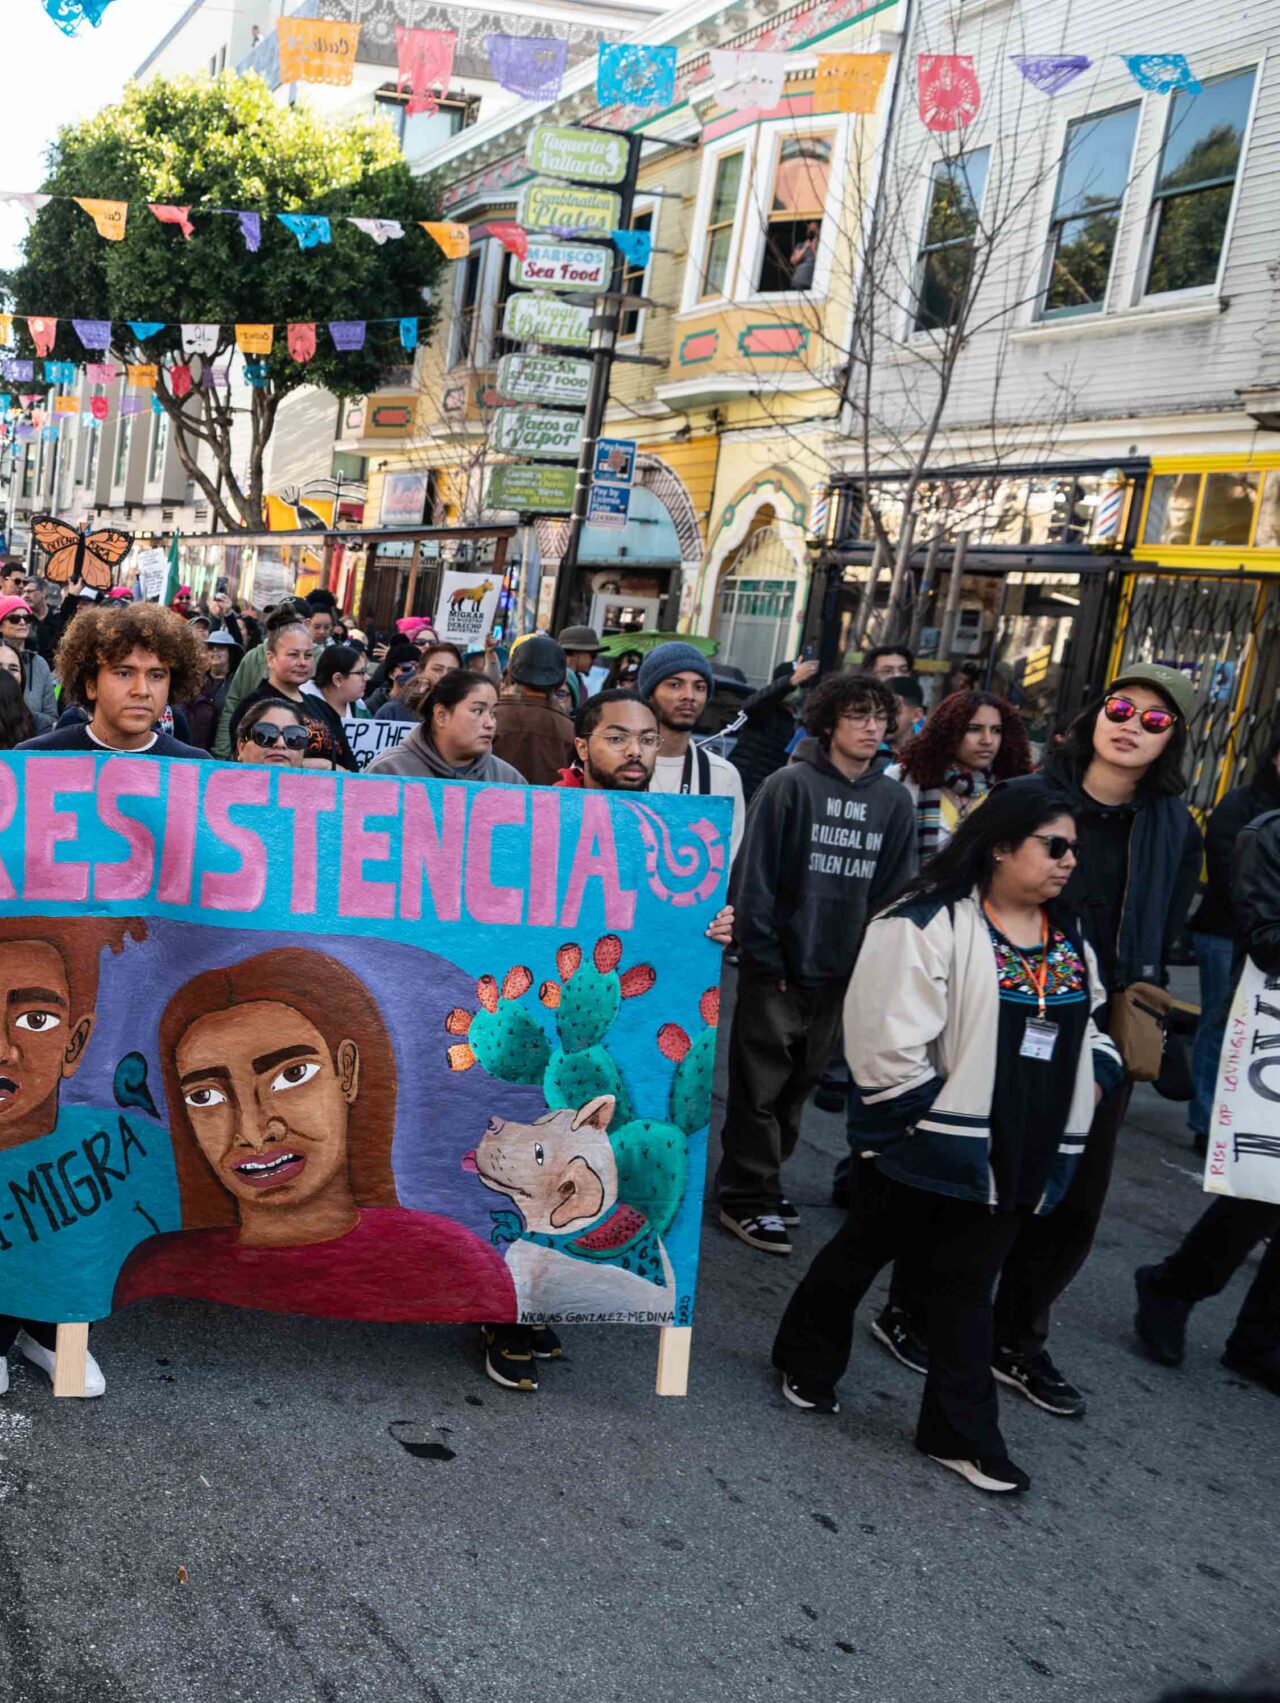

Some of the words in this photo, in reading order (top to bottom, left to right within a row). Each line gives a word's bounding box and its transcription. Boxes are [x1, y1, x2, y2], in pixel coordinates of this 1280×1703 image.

[541, 132, 606, 155] Taqueria
[540, 150, 606, 175] Vallarta
[533, 190, 610, 210] Combination
[532, 203, 607, 229] Plates
[526, 247, 604, 264] MARISCOS
[524, 260, 556, 279] Sea
[560, 264, 601, 282] Food
[556, 375, 589, 388] FOOD
[515, 415, 560, 432] Tacos
[563, 420, 580, 432] al
[506, 427, 577, 448] Vapor
[447, 621, 482, 629] DERECHO
[448, 610, 485, 619] MIGRAR
[375, 722, 412, 750] THE
[827, 797, 842, 817] NO
[844, 800, 867, 821] ONE
[819, 825, 862, 849] ILLEGAL
[866, 832, 883, 851] ON
[1218, 1102, 1234, 1127] UP
[1210, 1140, 1228, 1176] RISE
